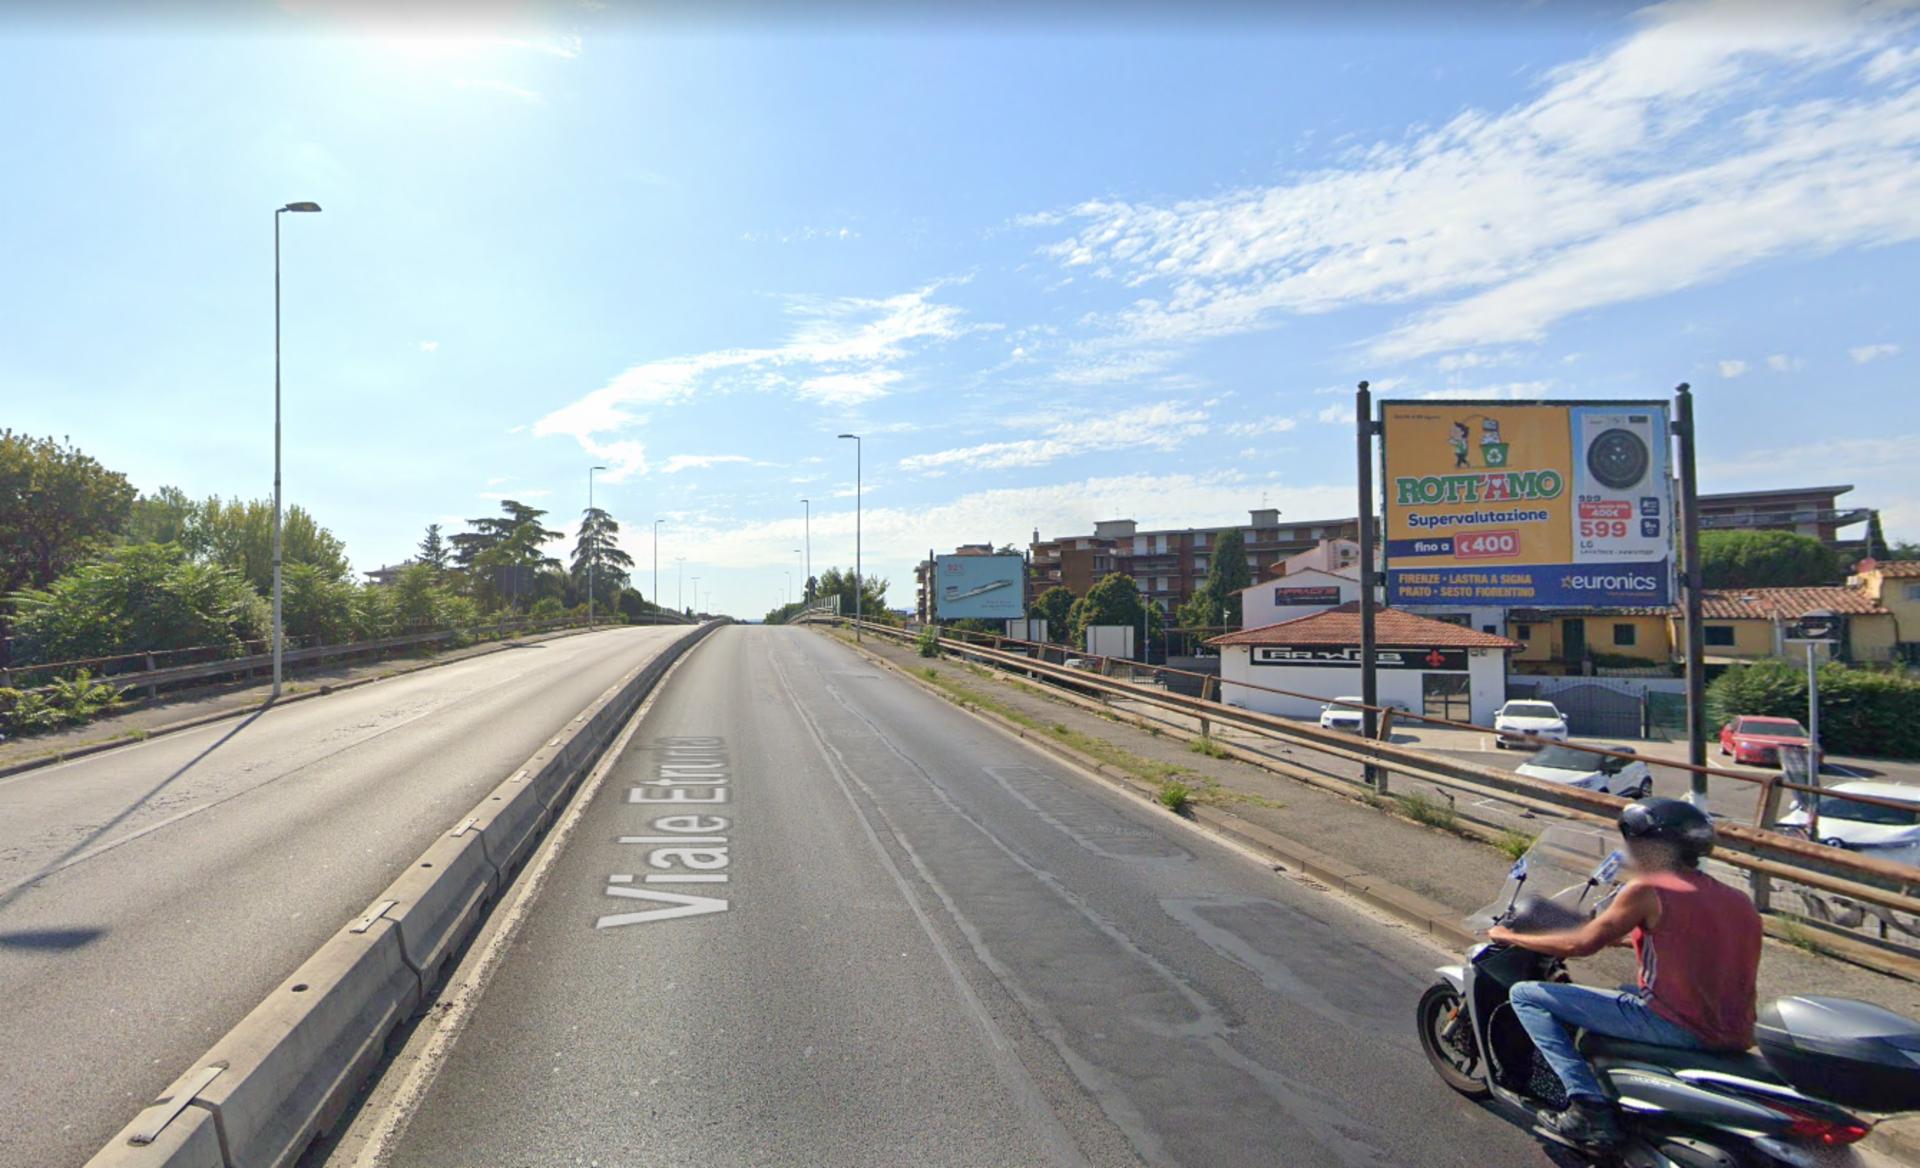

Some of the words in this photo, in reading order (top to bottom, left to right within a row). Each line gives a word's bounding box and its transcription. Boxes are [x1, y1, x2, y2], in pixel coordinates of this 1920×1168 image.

[1408, 508, 1548, 529] Supervalutazione
[1580, 521, 1627, 538] 599
[1414, 541, 1438, 552] fino
[1441, 543, 1449, 551] a
[1399, 573, 1440, 584] FIRENZE
[1449, 574, 1488, 584] LASTRA
[1491, 574, 1498, 584] A
[1501, 574, 1533, 584] SIGNA
[1572, 573, 1656, 589] euronics
[1399, 587, 1431, 597] PRATO
[1440, 586, 1472, 597] SESTO
[1476, 586, 1536, 597] FIORENTINO
